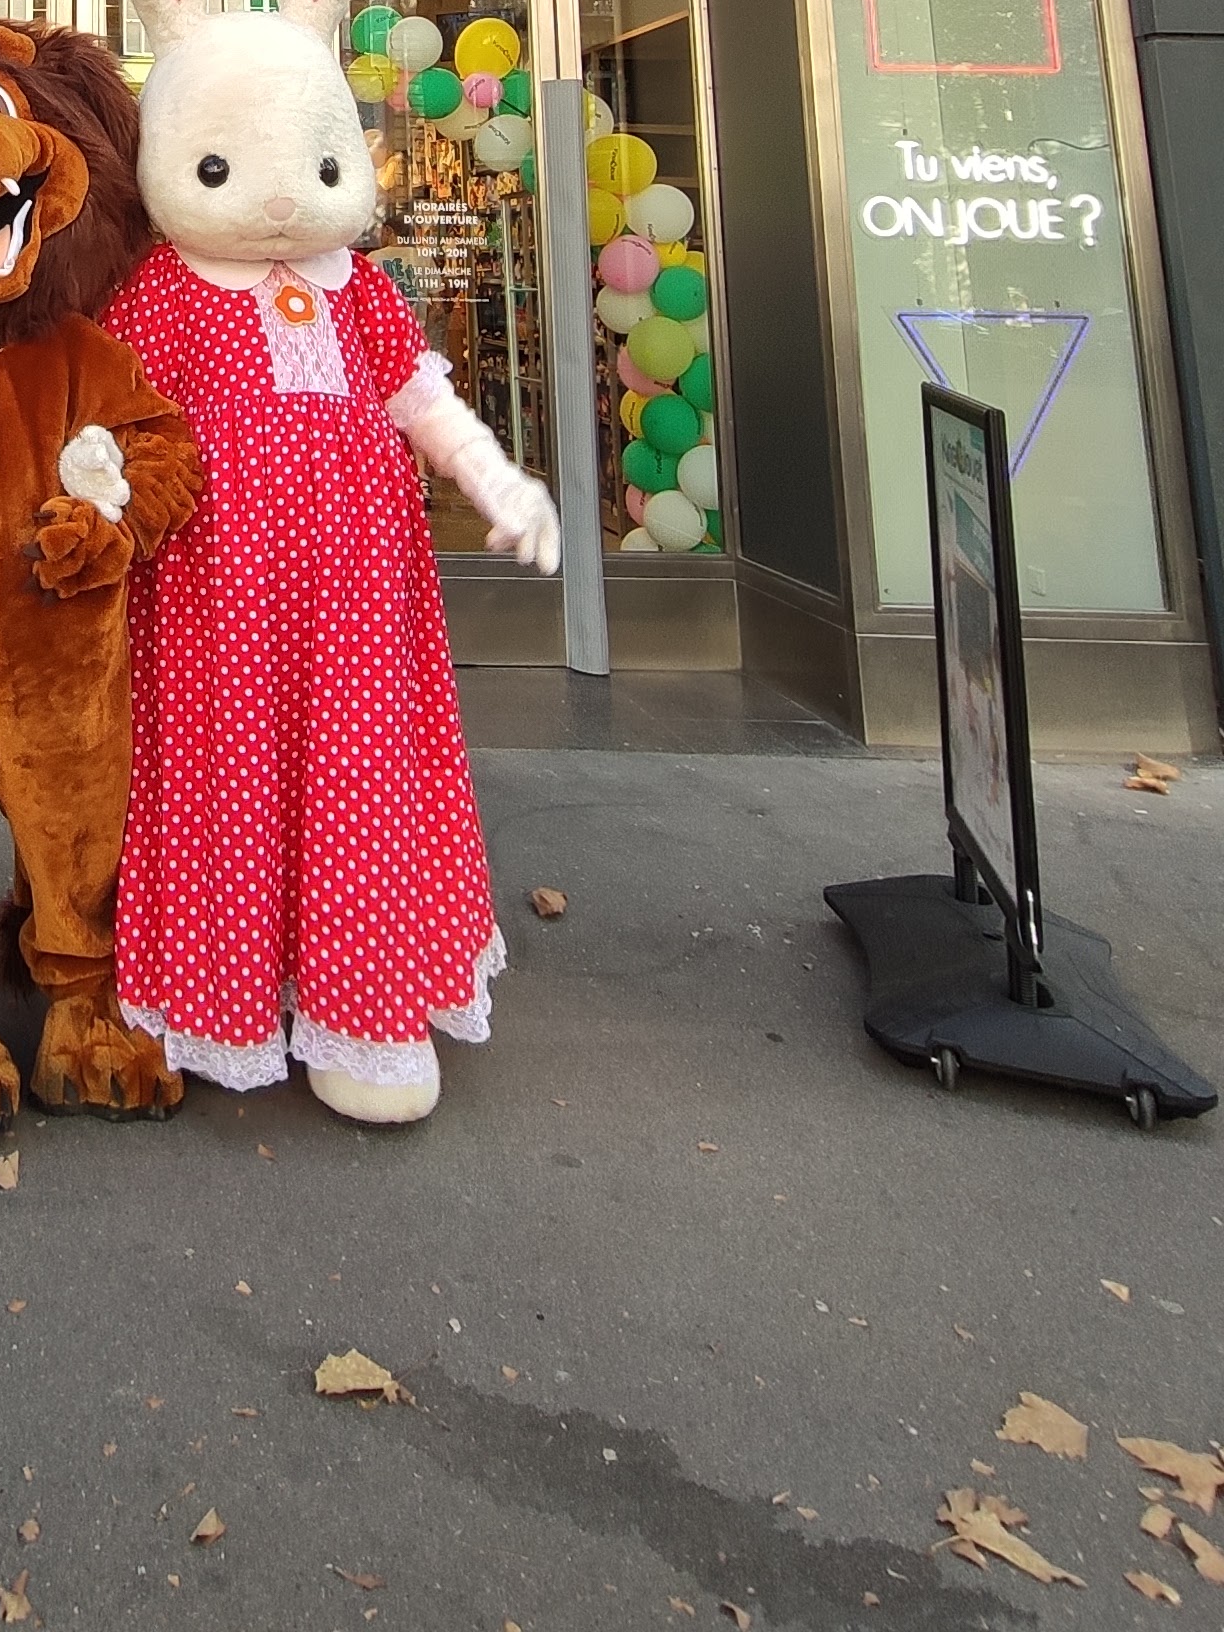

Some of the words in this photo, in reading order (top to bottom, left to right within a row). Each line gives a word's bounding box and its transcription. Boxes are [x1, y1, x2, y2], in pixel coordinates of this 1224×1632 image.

[894, 140, 938, 182] Tu
[950, 145, 1057, 190] viens,
[413, 202, 468, 212] HORAIRES
[403, 215, 478, 225] D'OUVERTURE
[862, 195, 945, 237] ON
[943, 196, 1065, 245] JOUE
[1069, 193, 1102, 247] ?
[397, 236, 410, 245] DU
[412, 236, 437, 245] LUNDI
[440, 236, 453, 245] AU
[455, 236, 487, 245] SAMEDI
[417, 249, 436, 257] 10H
[446, 248, 467, 257] 20H
[425, 267, 471, 275] DIMANCHE
[418, 279, 438, 288] 11H
[448, 279, 469, 288] 19H
